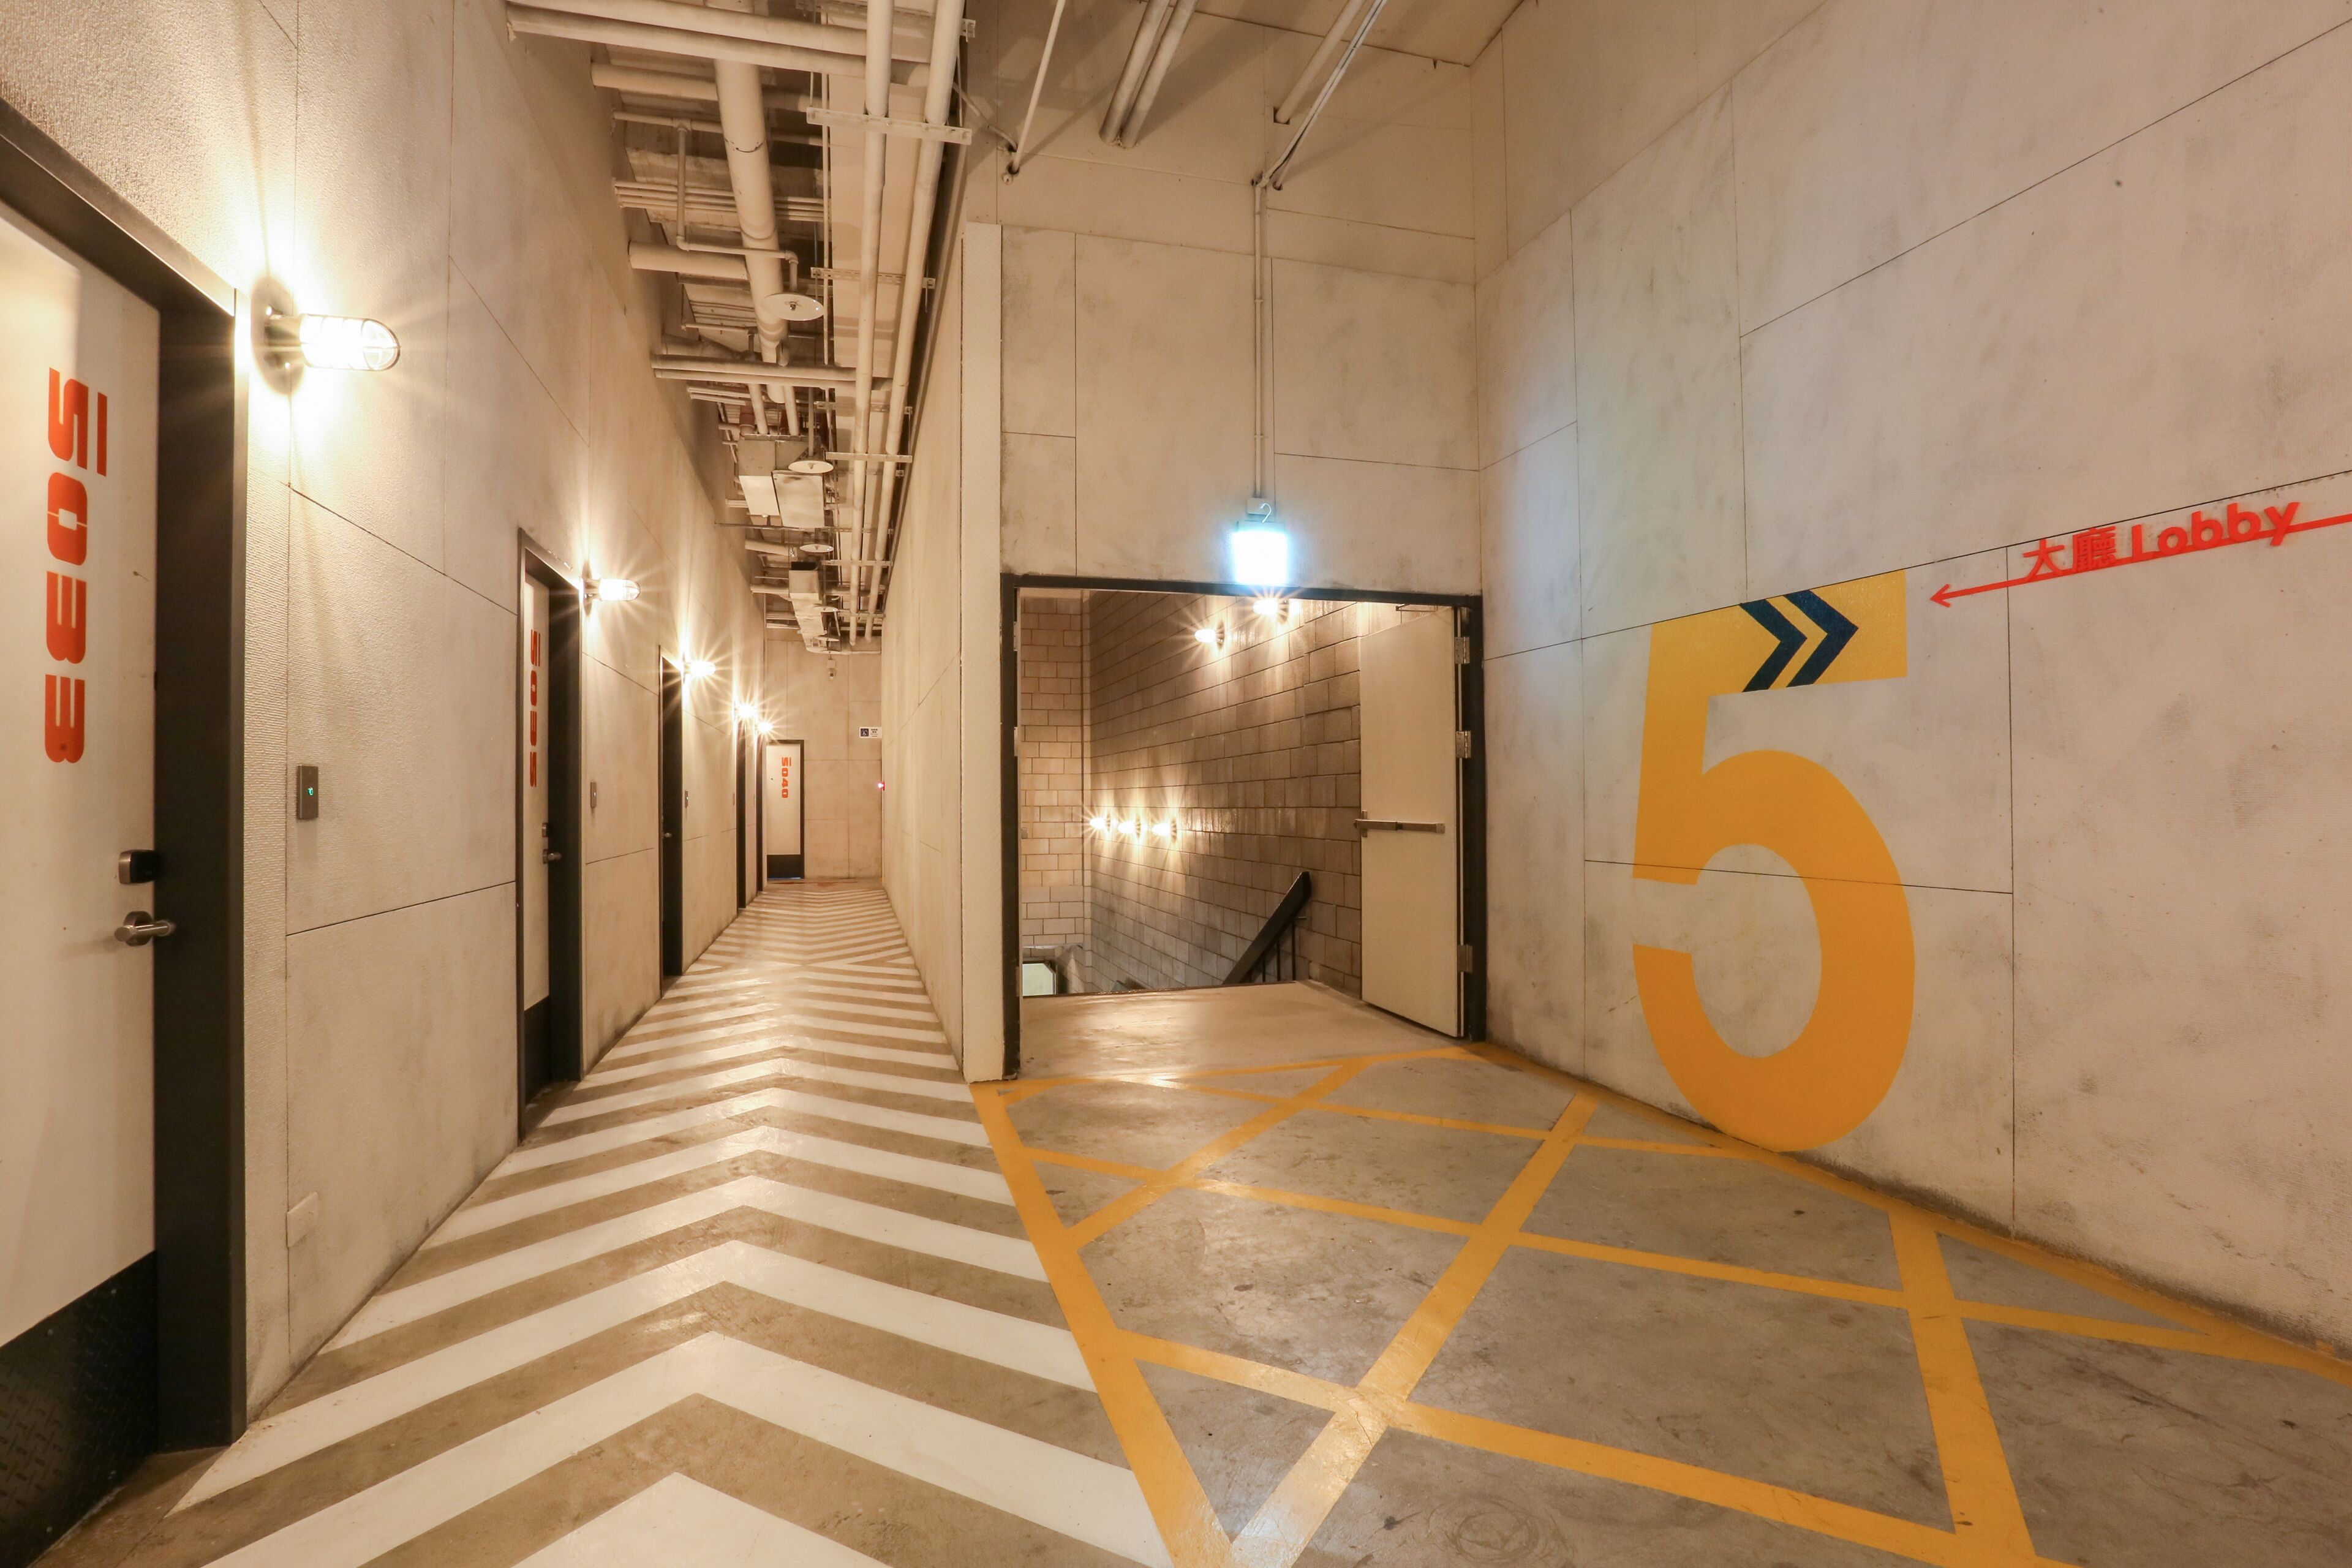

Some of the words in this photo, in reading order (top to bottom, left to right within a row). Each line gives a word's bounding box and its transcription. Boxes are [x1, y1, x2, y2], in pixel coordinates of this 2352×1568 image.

[2023, 526, 2116, 582] 大廳
[2132, 502, 2299, 560] Lobby
[1632, 569, 1915, 1152] 5
